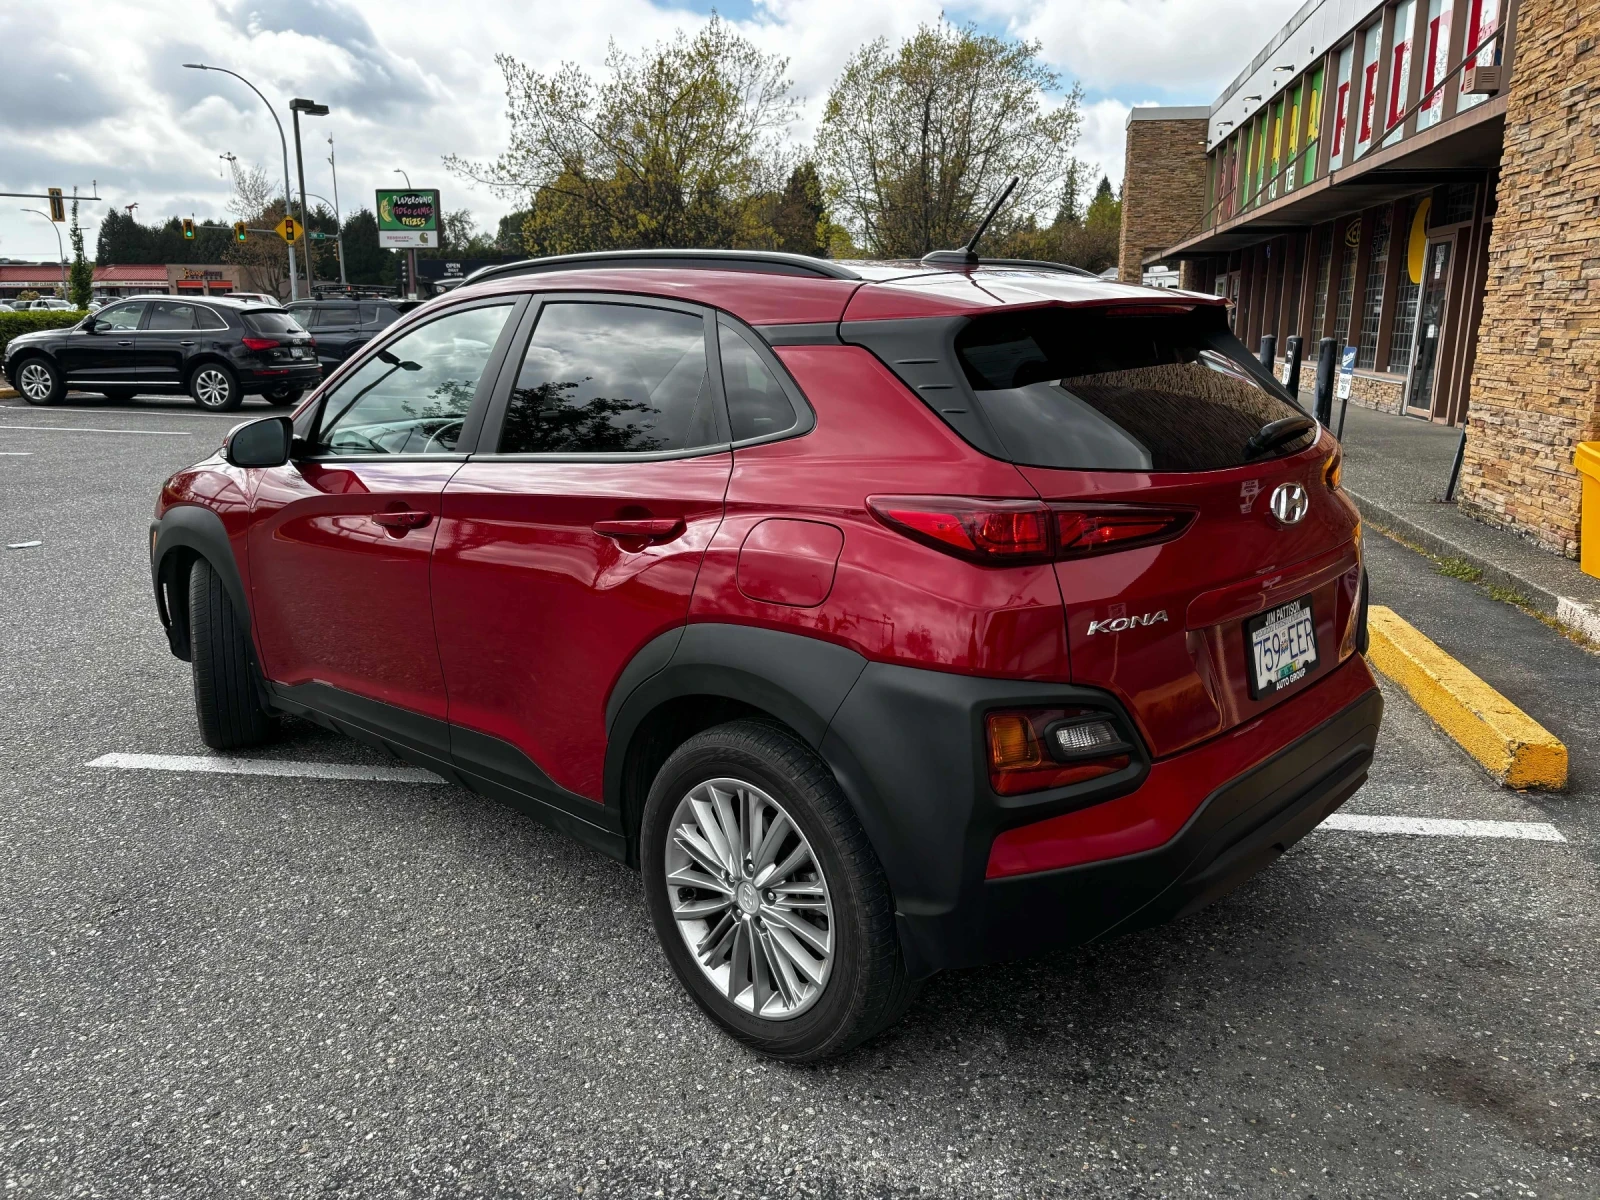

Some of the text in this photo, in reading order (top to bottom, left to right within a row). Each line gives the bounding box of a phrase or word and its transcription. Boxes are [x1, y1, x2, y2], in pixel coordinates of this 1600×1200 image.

[392, 195, 433, 205] PLAYGROUND
[1086, 609, 1169, 636] KONA
[1265, 600, 1301, 626] JIM PATTISON
[1253, 633, 1281, 677] 759
[1287, 617, 1316, 660] EER
[1276, 677, 1290, 691] AUTO
[1289, 667, 1306, 683] GROUP
